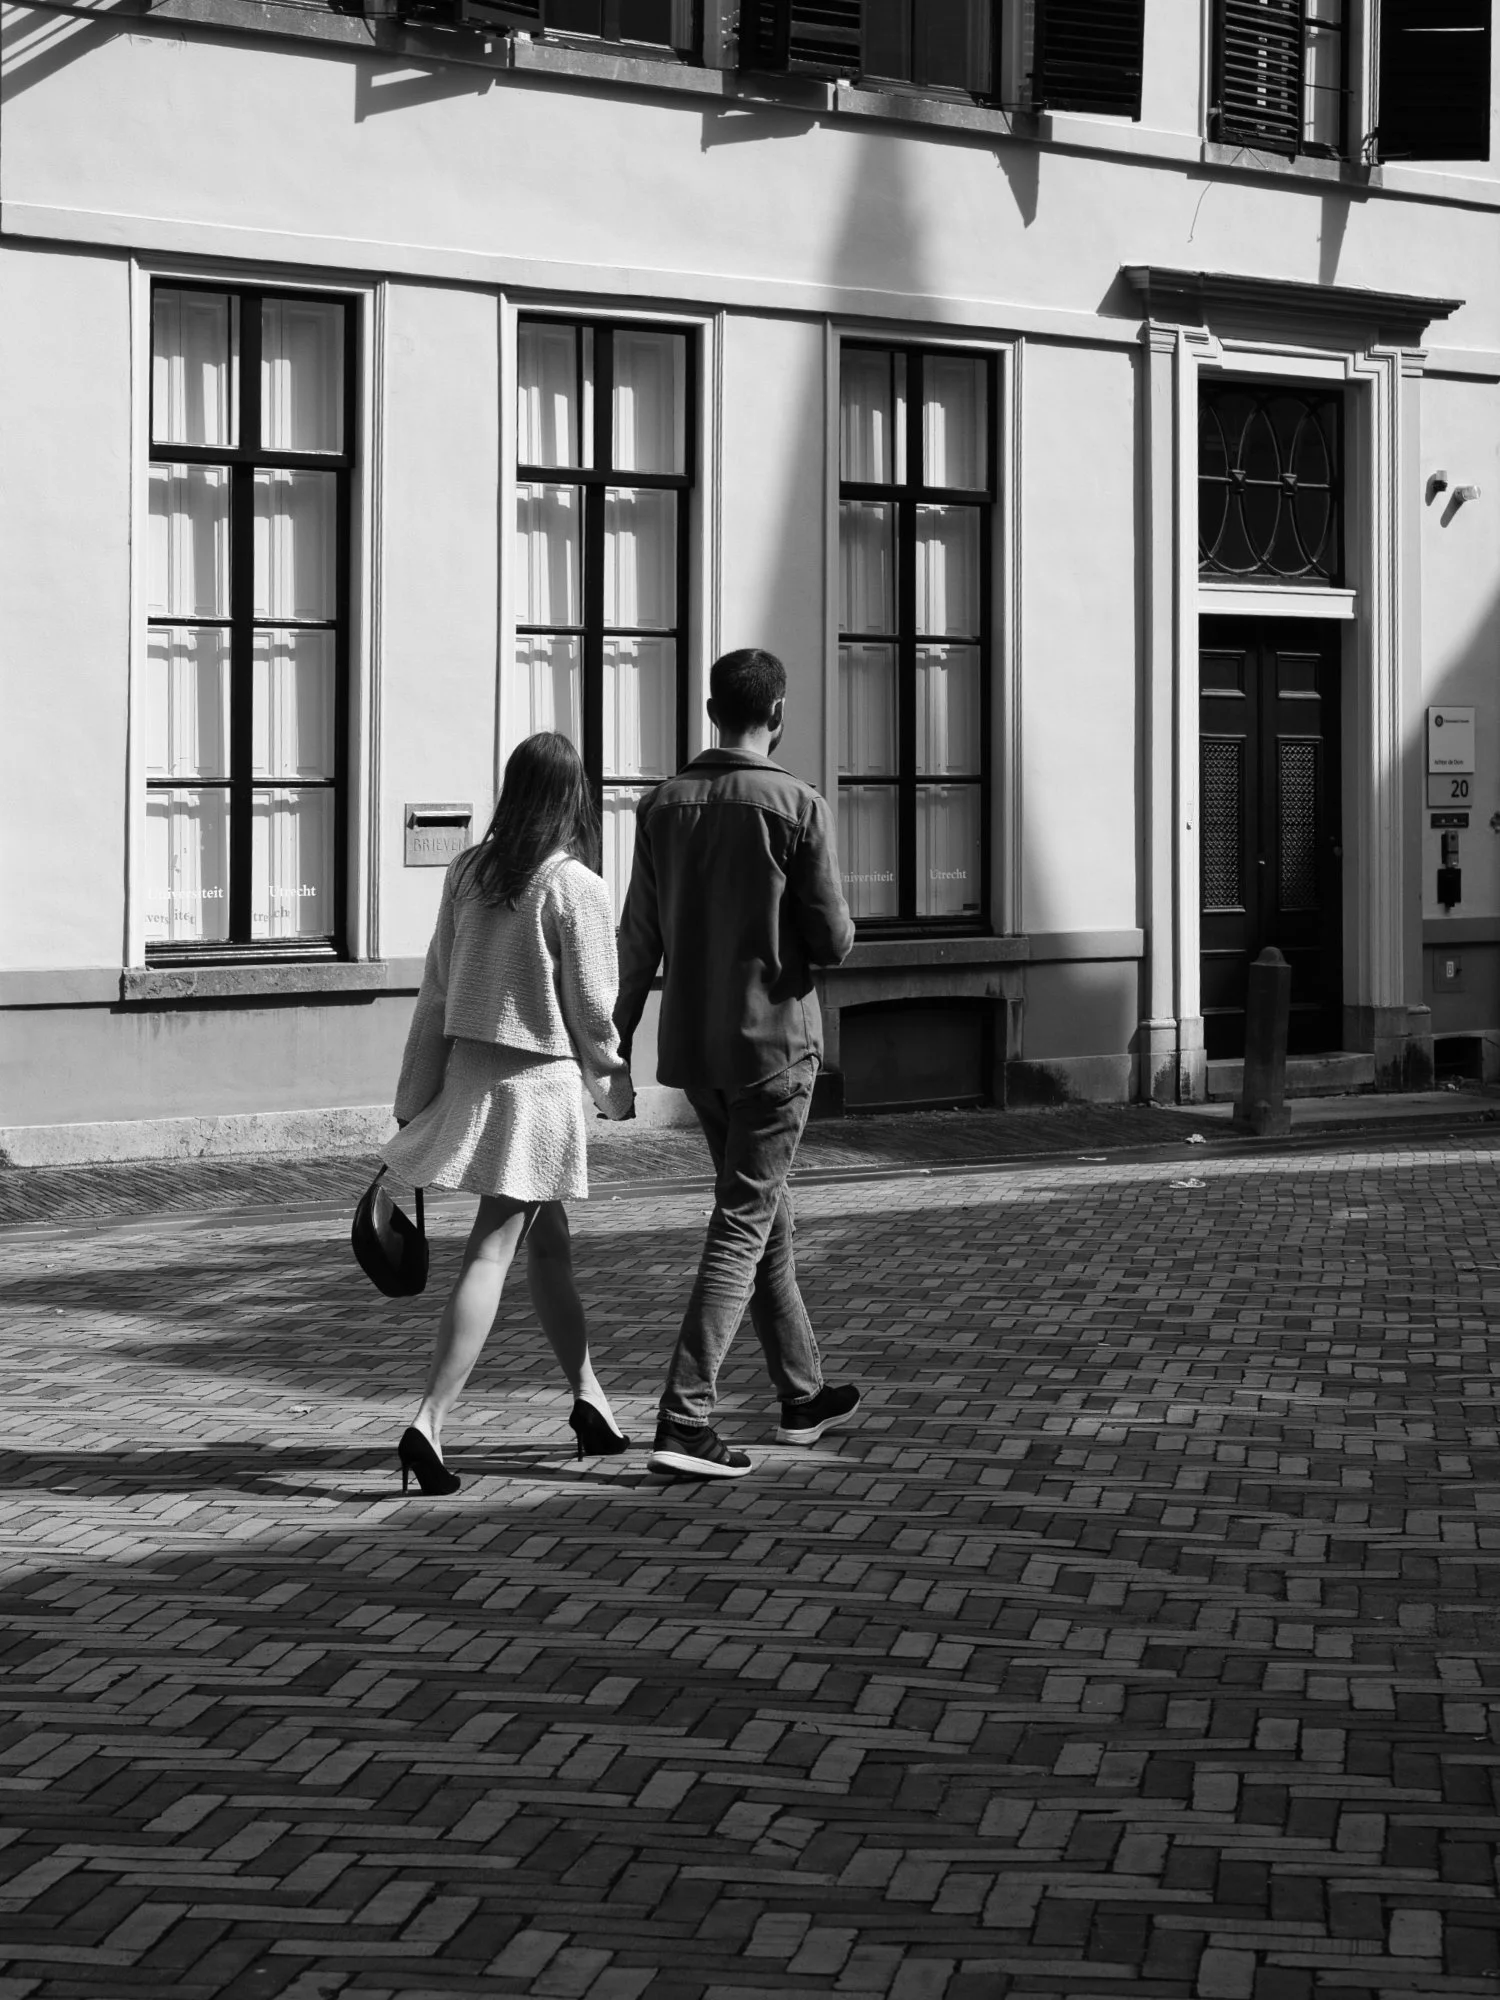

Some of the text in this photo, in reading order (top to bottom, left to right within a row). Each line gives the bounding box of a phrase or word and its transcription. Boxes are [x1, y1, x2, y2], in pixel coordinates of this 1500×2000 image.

[1451, 779, 1469, 798] 20
[413, 838, 465, 852] BRIEVEN
[929, 868, 967, 880] Utrecht
[147, 884, 317, 900] Universiteit Utrecht
